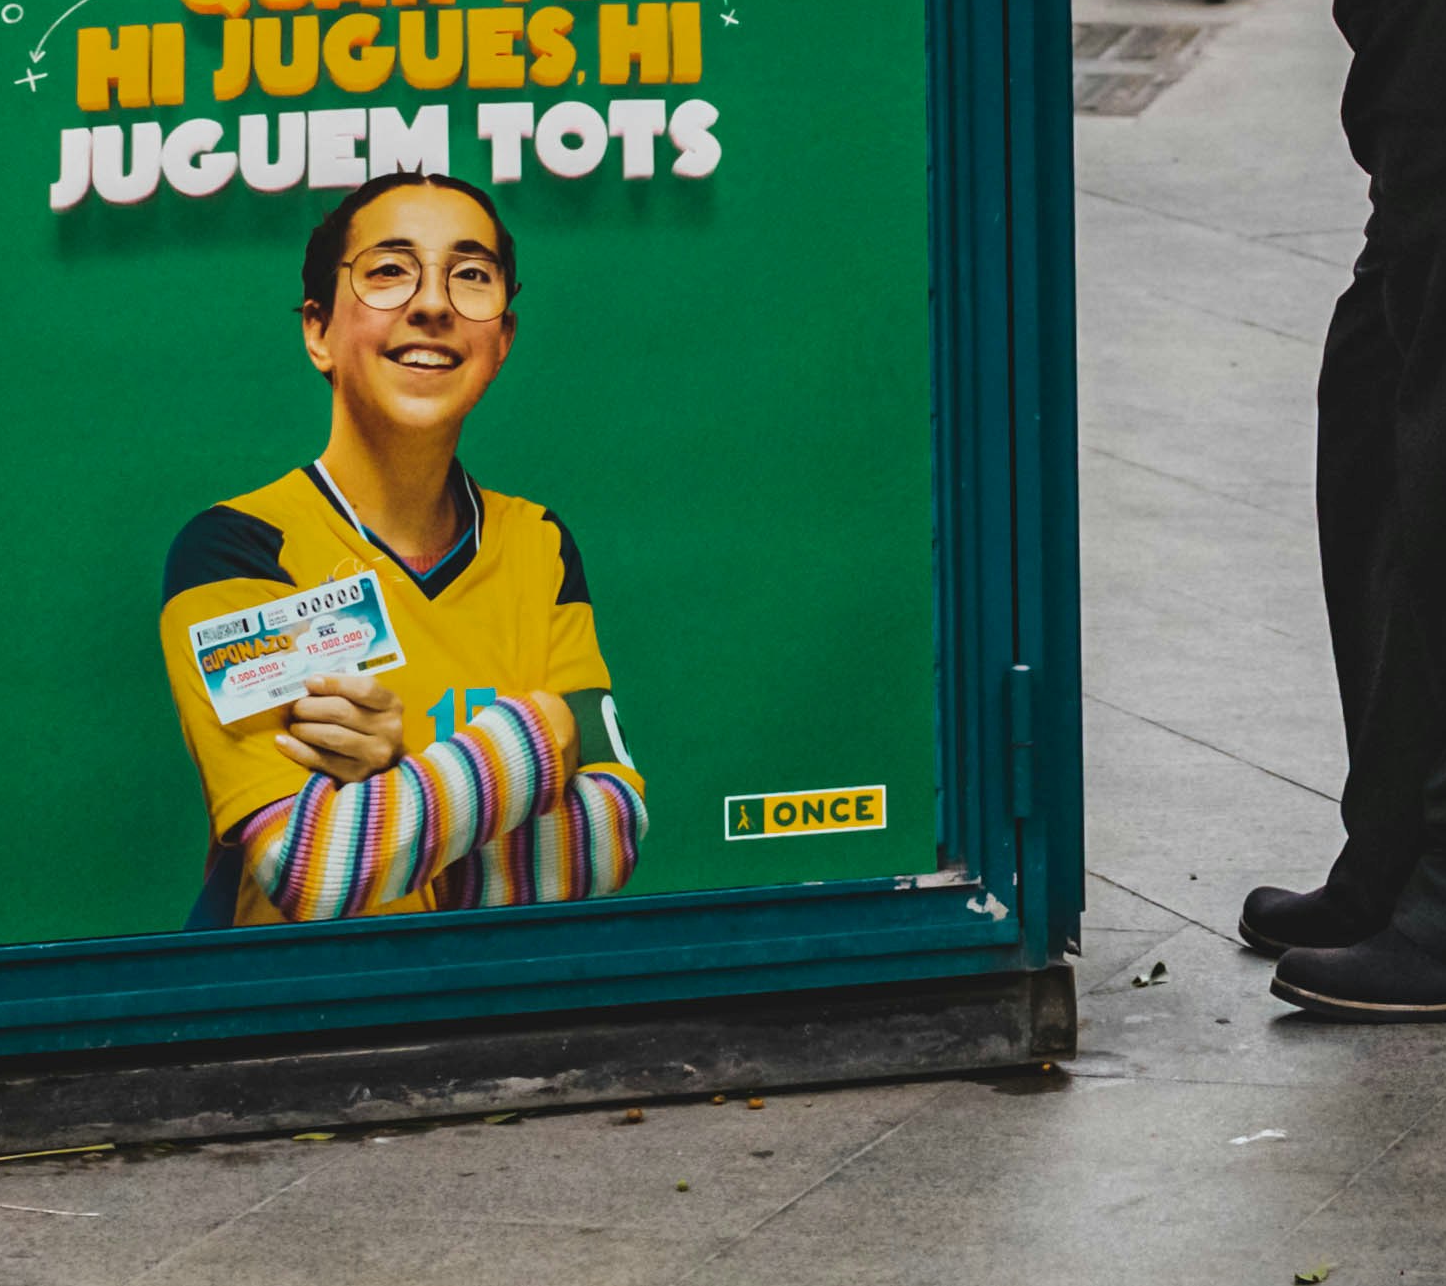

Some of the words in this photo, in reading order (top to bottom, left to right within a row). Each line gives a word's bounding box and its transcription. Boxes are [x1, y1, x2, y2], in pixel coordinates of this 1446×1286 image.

[76, 22, 186, 112] HI
[598, 1, 703, 85] HI
[49, 102, 452, 212] JUGUEM
[477, 98, 723, 184] TOTS
[202, 633, 294, 675] CUPONAZO
[772, 794, 875, 827] ONCE
